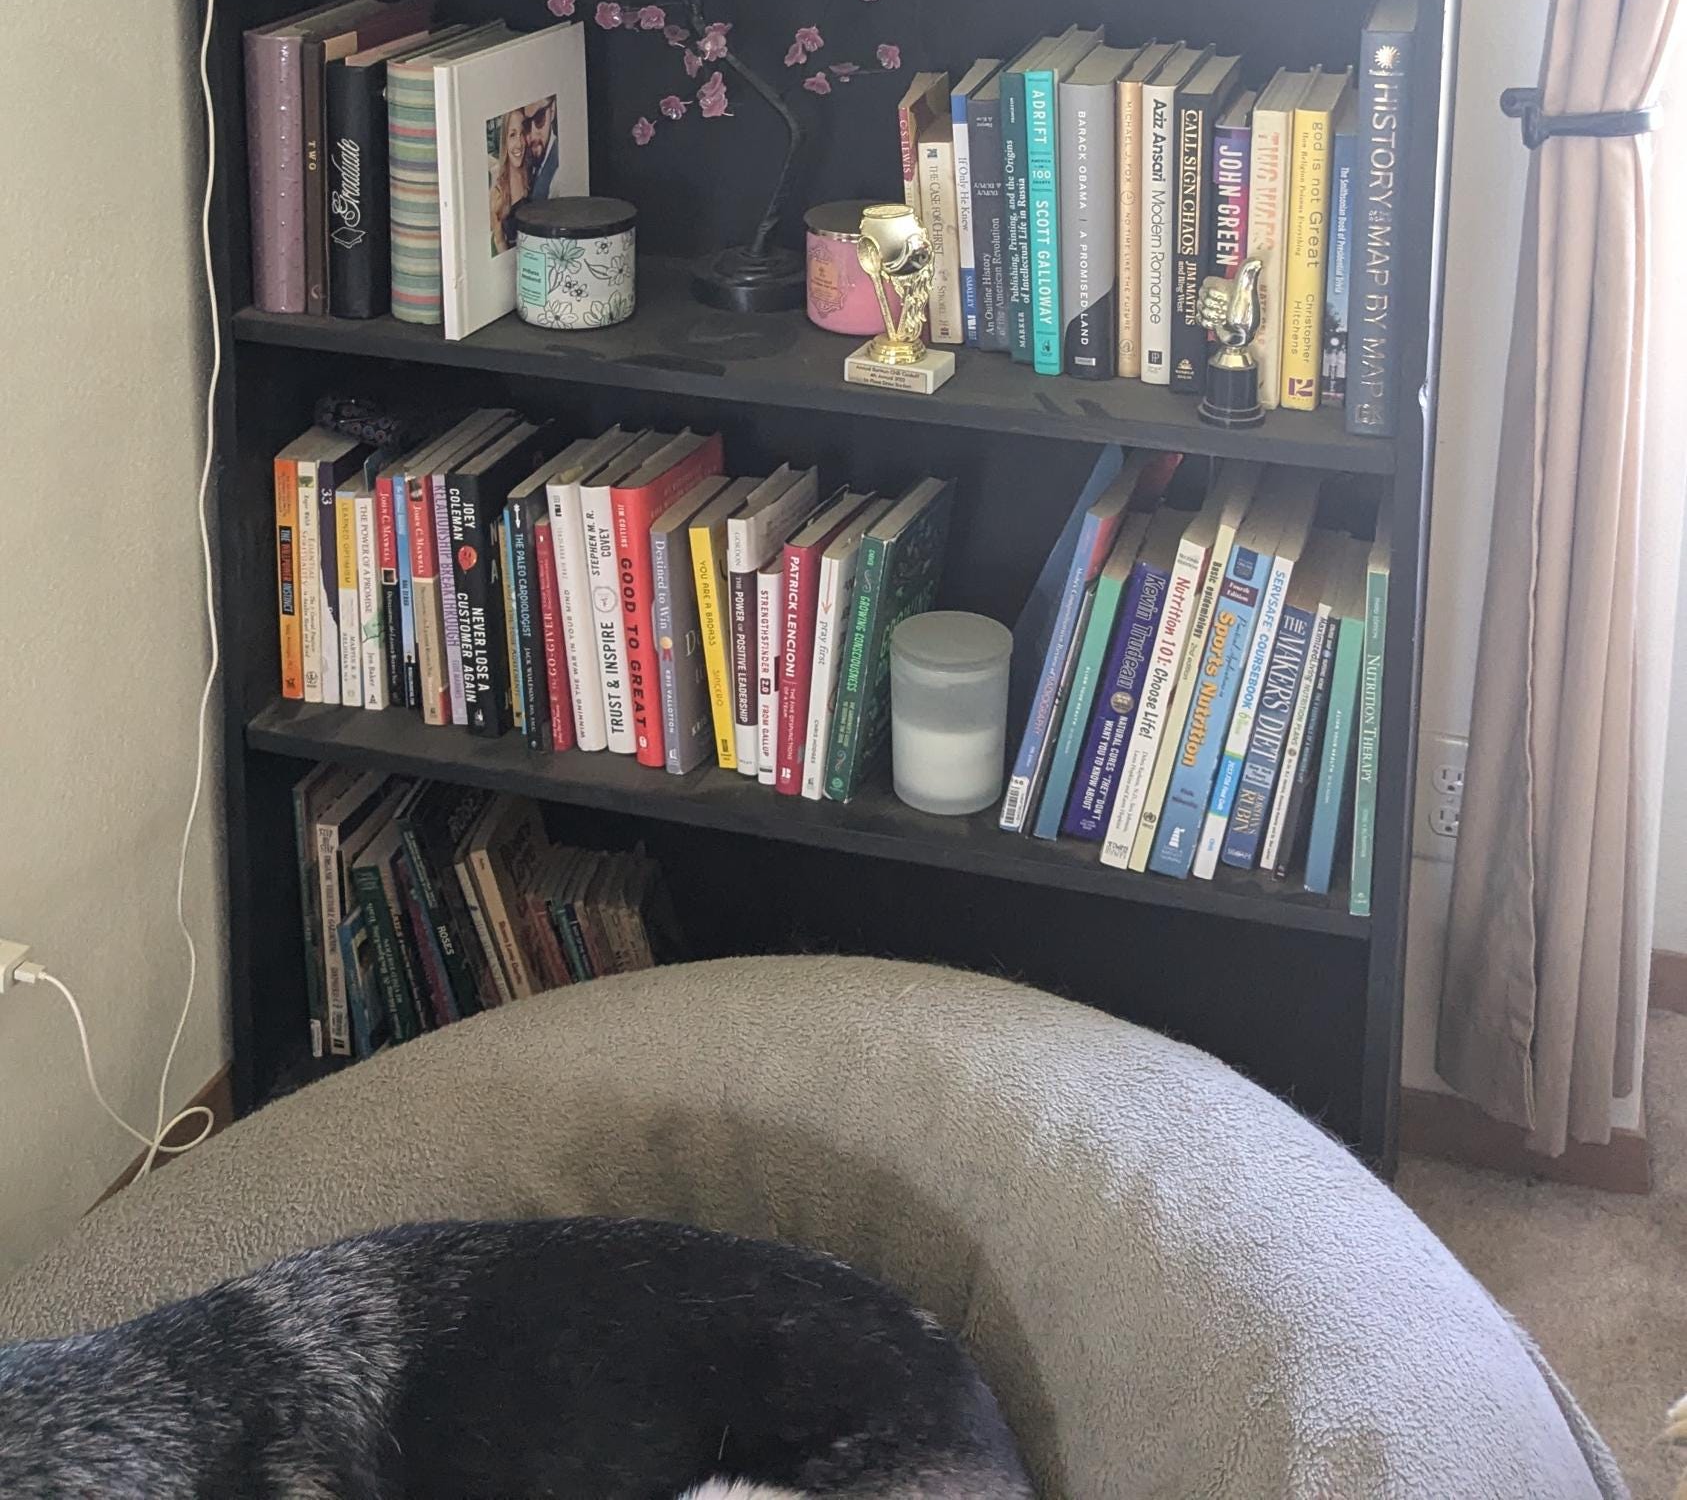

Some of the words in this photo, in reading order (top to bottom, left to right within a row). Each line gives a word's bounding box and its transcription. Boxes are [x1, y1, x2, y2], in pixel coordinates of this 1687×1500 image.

[1031, 90, 1047, 144] ADRIFT
[1152, 99, 1167, 129] Aziz
[1183, 110, 1198, 153] CALL
[1077, 111, 1087, 160] BARACK
[1312, 122, 1324, 151] god
[1370, 83, 1397, 208] HISTORY
[308, 140, 317, 170] TWO
[1005, 140, 1015, 173] Origins
[1152, 132, 1166, 182] Ansari
[1217, 145, 1242, 197] JOHN
[1312, 158, 1323, 171] is
[331, 138, 361, 228] Graduate
[1006, 176, 1014, 190] the
[1017, 178, 1026, 207] Russia
[1032, 170, 1051, 179] 100
[1078, 165, 1088, 209] OBAMA
[1183, 156, 1197, 197] SIGN
[1310, 178, 1322, 203] not
[1007, 193, 1016, 209] and
[1018, 210, 1026, 219] in
[1124, 212, 1131, 226] NO
[1150, 190, 1165, 248] Modern
[1008, 213, 1019, 251] Printing,
[1019, 221, 1028, 240] Life
[1034, 200, 1050, 244] SCOTT
[1079, 231, 1088, 239] A
[1123, 230, 1131, 249] TIME
[1181, 200, 1196, 255] CHAOS
[1215, 204, 1239, 266] GREEN
[1305, 210, 1323, 268] Great
[1020, 242, 1029, 291] Intellectual
[1123, 252, 1131, 272] LIKE
[1186, 261, 1197, 282] JIM
[1365, 225, 1391, 285] MAP
[1009, 254, 1020, 302] Publishing,
[1037, 250, 1052, 325] GALLOWAY
[1079, 243, 1089, 308] PROMISED
[1123, 275, 1131, 293] THE
[1149, 251, 1164, 324] Romance
[1021, 293, 1029, 303] of
[1123, 296, 1131, 331] FUTURE
[1185, 283, 1197, 326] MATTIS
[1362, 293, 1388, 330] BY
[1080, 313, 1089, 345] LAND
[1291, 300, 1302, 355] Hitchens
[1302, 293, 1315, 363] Christopher
[1360, 337, 1385, 397] MAP
[321, 488, 332, 505] 33
[449, 488, 463, 540] COLEMAN
[462, 502, 476, 528] JOEY
[617, 504, 625, 516] JIM
[514, 533, 524, 548] THE
[598, 527, 611, 557] COVEY
[618, 518, 628, 548] COLLINS
[733, 531, 742, 567] GORDON
[515, 551, 526, 578] PALEO
[654, 539, 667, 592] Destined
[787, 556, 800, 610] PATRICK
[619, 557, 636, 613] GOOD
[657, 592, 667, 604] to
[1134, 573, 1166, 621] Kevin
[1262, 570, 1285, 628] SERVSAFE
[457, 592, 472, 658] CUSTOMER
[517, 579, 532, 637] CARDIOLOGIST
[658, 606, 669, 630] Win
[855, 595, 871, 631] GROWING
[1164, 576, 1192, 636] Nutrition
[1283, 614, 1307, 636] THE
[472, 607, 485, 646] NEVER
[543, 611, 557, 675] GO-GIVER
[626, 624, 640, 650] TO
[785, 613, 798, 678] LENCIONI
[816, 621, 831, 643] pray
[1205, 612, 1236, 676] Sports
[475, 650, 488, 679] LOSE
[816, 645, 830, 666] first
[846, 632, 865, 692] CONSCIOUSNESS
[1116, 623, 1152, 689] Trudeau
[1156, 638, 1177, 667] 101:
[1241, 633, 1269, 710] COURSEBOOK
[1261, 630, 1306, 713] MAKER'S
[463, 665, 477, 702] AGAIN
[477, 683, 490, 691] A
[629, 660, 647, 728] GREAT
[1146, 667, 1169, 708] Choose
[1363, 654, 1381, 724] NUTRITION
[1101, 719, 1114, 740] WANT
[1139, 711, 1159, 739] Life!
[1181, 681, 1220, 766] Nutrition
[1250, 714, 1286, 763] DIET
[1094, 755, 1105, 765] TO
[1096, 741, 1109, 754] YOU
[1359, 727, 1377, 783] THERAPY
[1087, 766, 1102, 787] KNOW
[1081, 787, 1097, 810] ABOUT
[1231, 789, 1257, 833] RUBIN
[436, 924, 455, 956] ROSES
